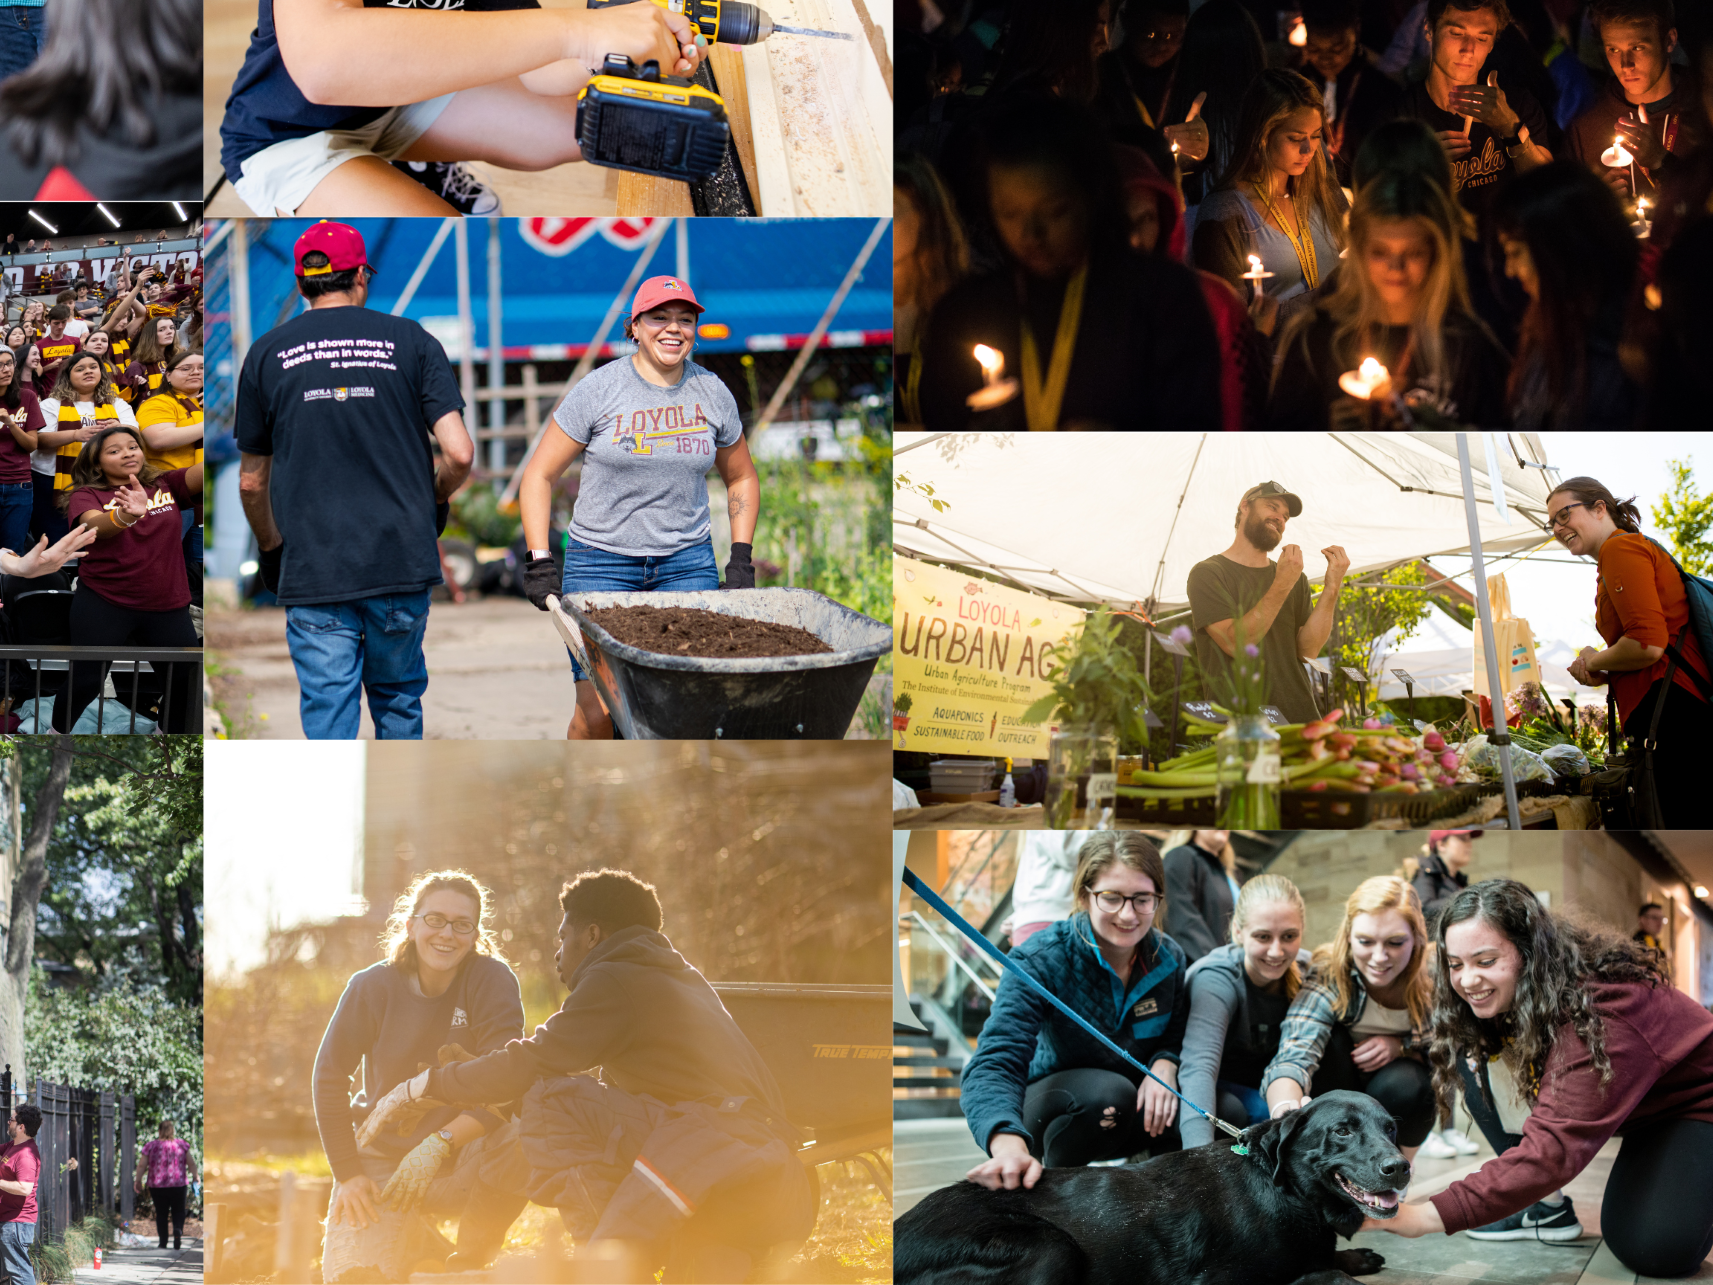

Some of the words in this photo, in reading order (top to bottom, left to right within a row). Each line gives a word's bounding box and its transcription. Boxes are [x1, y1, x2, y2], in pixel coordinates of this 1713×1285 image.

[1467, 175, 1498, 188] CHICAGO
[46, 345, 71, 356] Loyola
[307, 341, 317, 350] is
[318, 339, 354, 349] shown
[356, 339, 382, 349] more
[385, 340, 394, 349] in
[282, 354, 312, 370] deeds
[314, 349, 340, 360] than
[341, 348, 351, 358] in
[341, 360, 364, 369] Ignatius
[366, 361, 375, 369] of
[376, 362, 396, 371] Loyola
[304, 388, 331, 398] LOYOLA
[614, 403, 707, 437] LOYOLA
[631, 431, 653, 455] L
[656, 439, 675, 448] Since
[676, 436, 710, 455] 1870
[959, 595, 1021, 633] LOYOLA
[900, 611, 1010, 673] URBAN
[925, 664, 949, 680] Urban
[952, 669, 998, 688] Agriculture
[1002, 677, 1031, 695] Program
[902, 680, 917, 690] The
[918, 683, 950, 695] Institute
[950, 687, 958, 696] of
[959, 689, 1008, 703] Environmental
[933, 707, 984, 723] AQUAPONICS
[914, 726, 964, 740] SUSTAINABLE
[966, 730, 985, 741] FOOD
[998, 732, 1036, 744] OUTREACH
